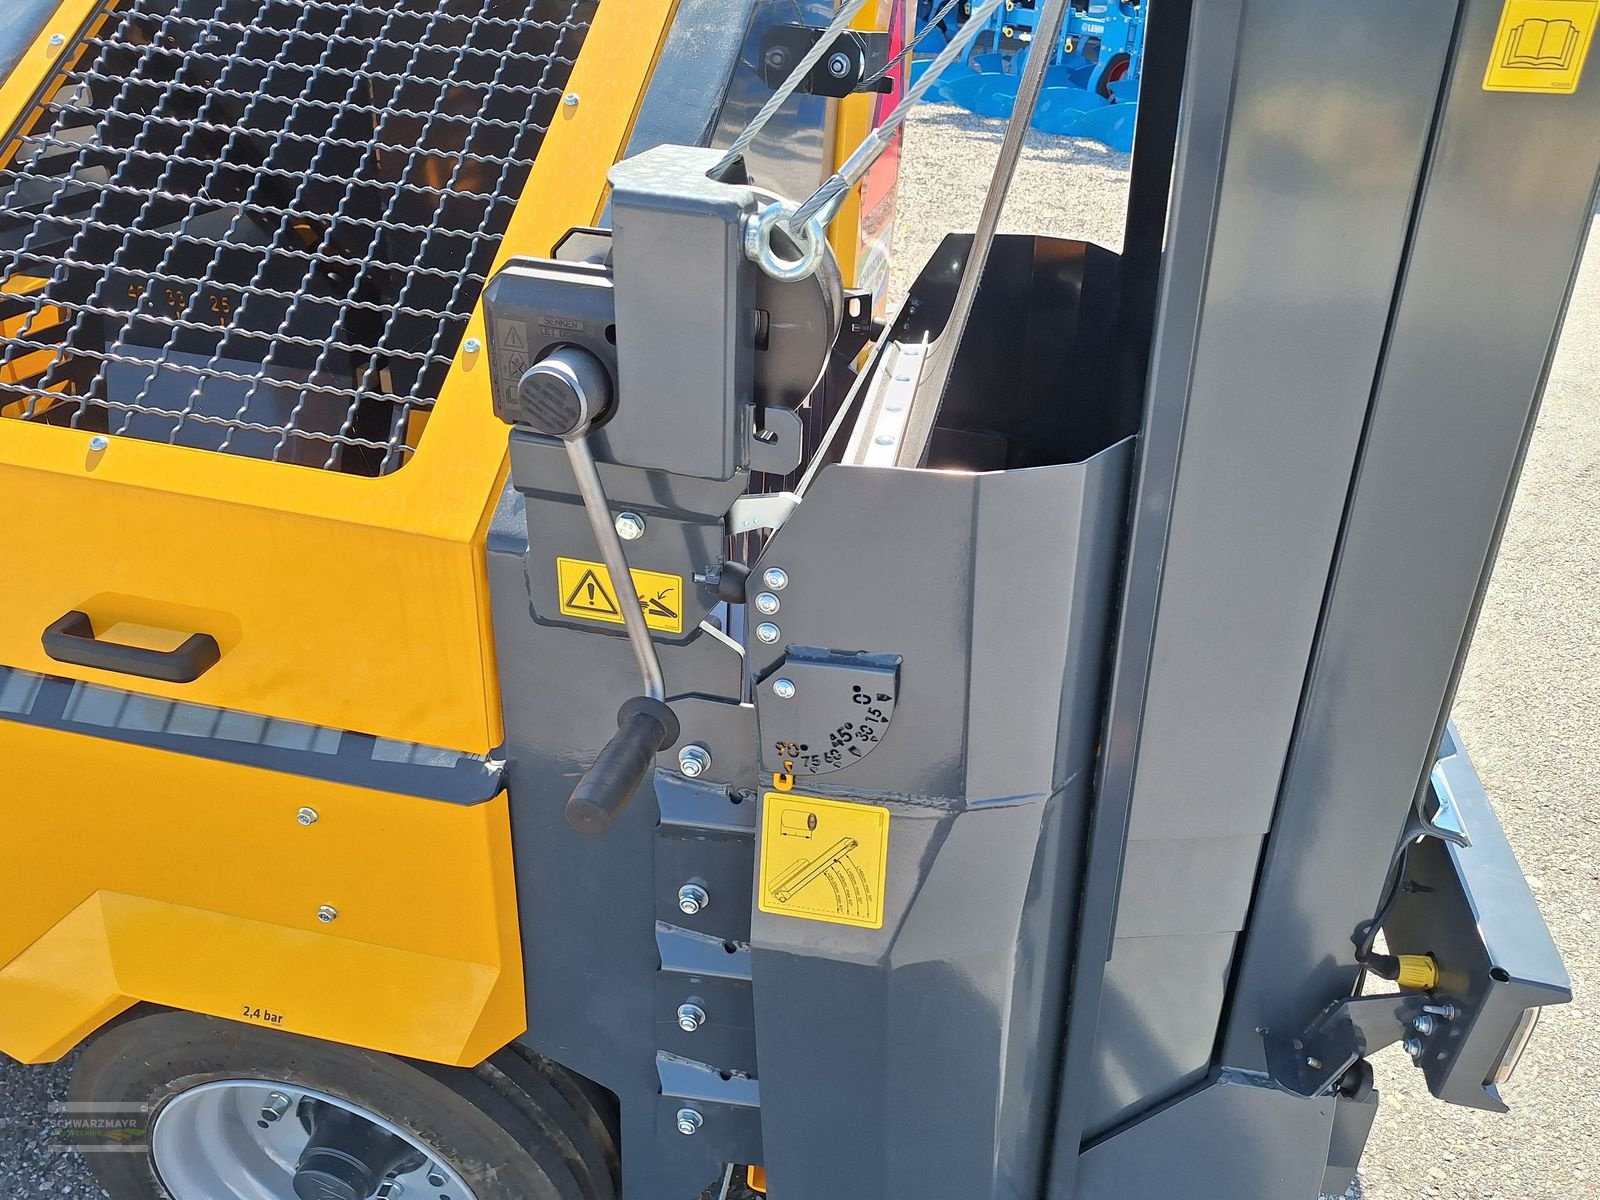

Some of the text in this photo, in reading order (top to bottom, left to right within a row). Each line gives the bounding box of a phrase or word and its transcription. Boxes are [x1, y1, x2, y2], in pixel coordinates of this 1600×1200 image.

[165, 289, 186, 307] 33
[209, 295, 230, 313] 25
[865, 707, 882, 723] 15
[855, 725, 874, 742] 30
[800, 755, 821, 767] 75
[243, 1005, 283, 1023] 2,4 bar
